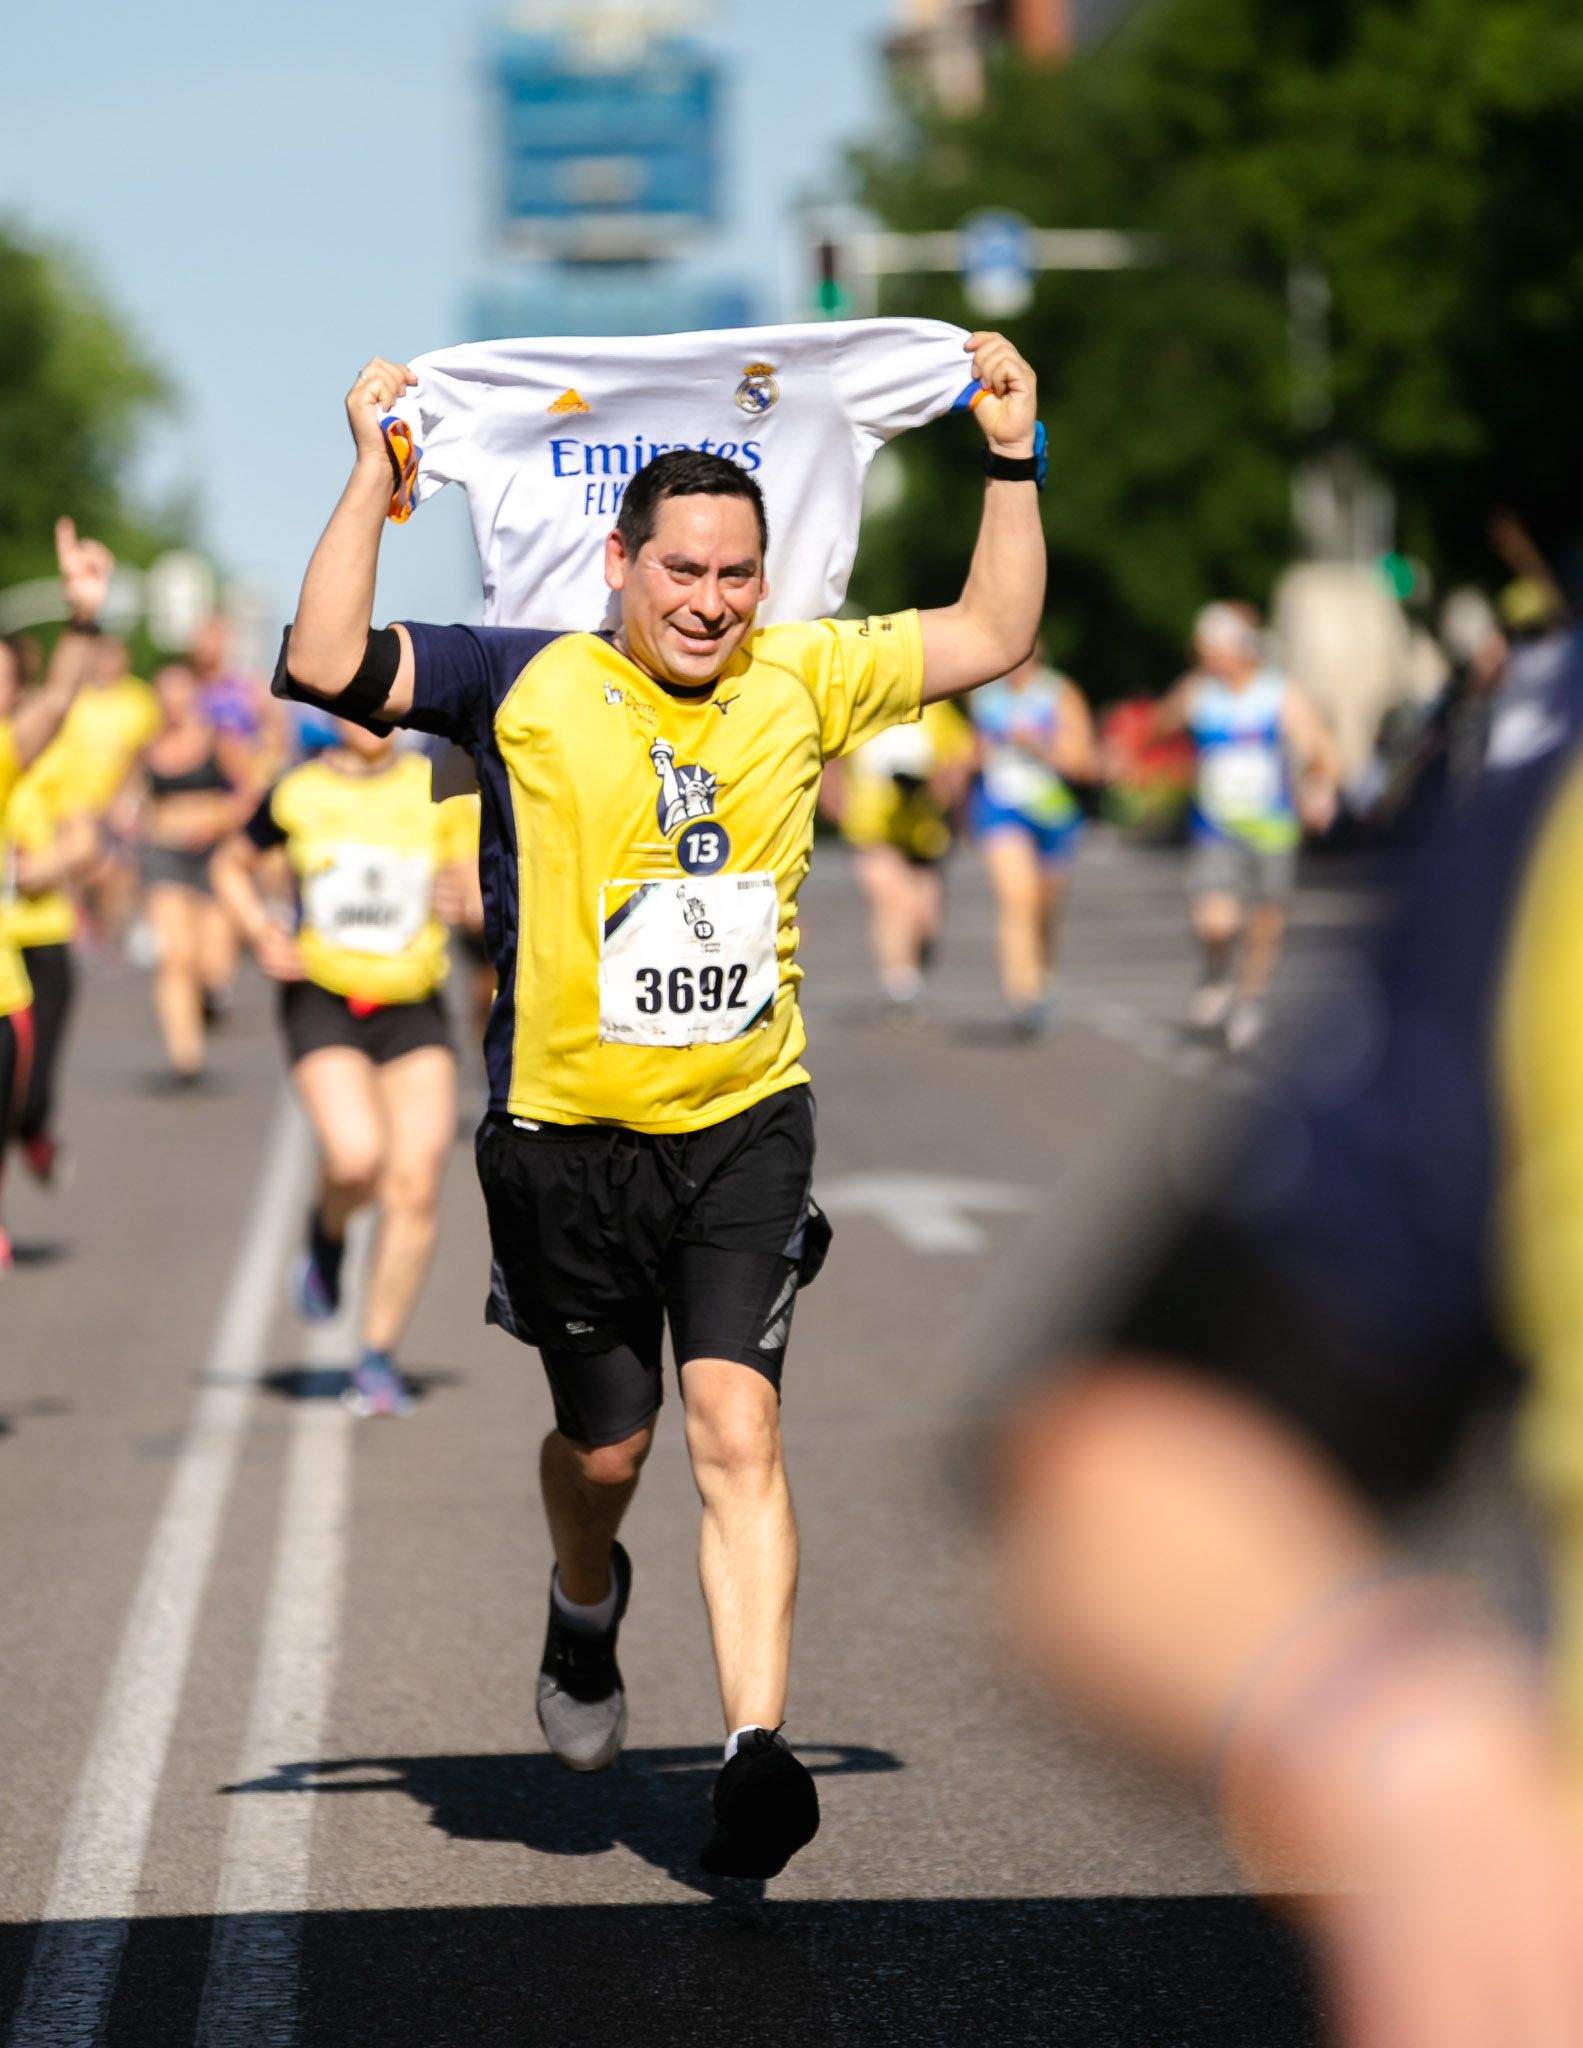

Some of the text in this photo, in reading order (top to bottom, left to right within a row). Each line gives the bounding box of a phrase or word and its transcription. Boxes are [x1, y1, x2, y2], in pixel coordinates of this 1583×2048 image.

[550, 435, 762, 477] Emirtes
[585, 481, 625, 515] FLY
[686, 832, 720, 864] 13
[636, 963, 748, 1014] 3692
